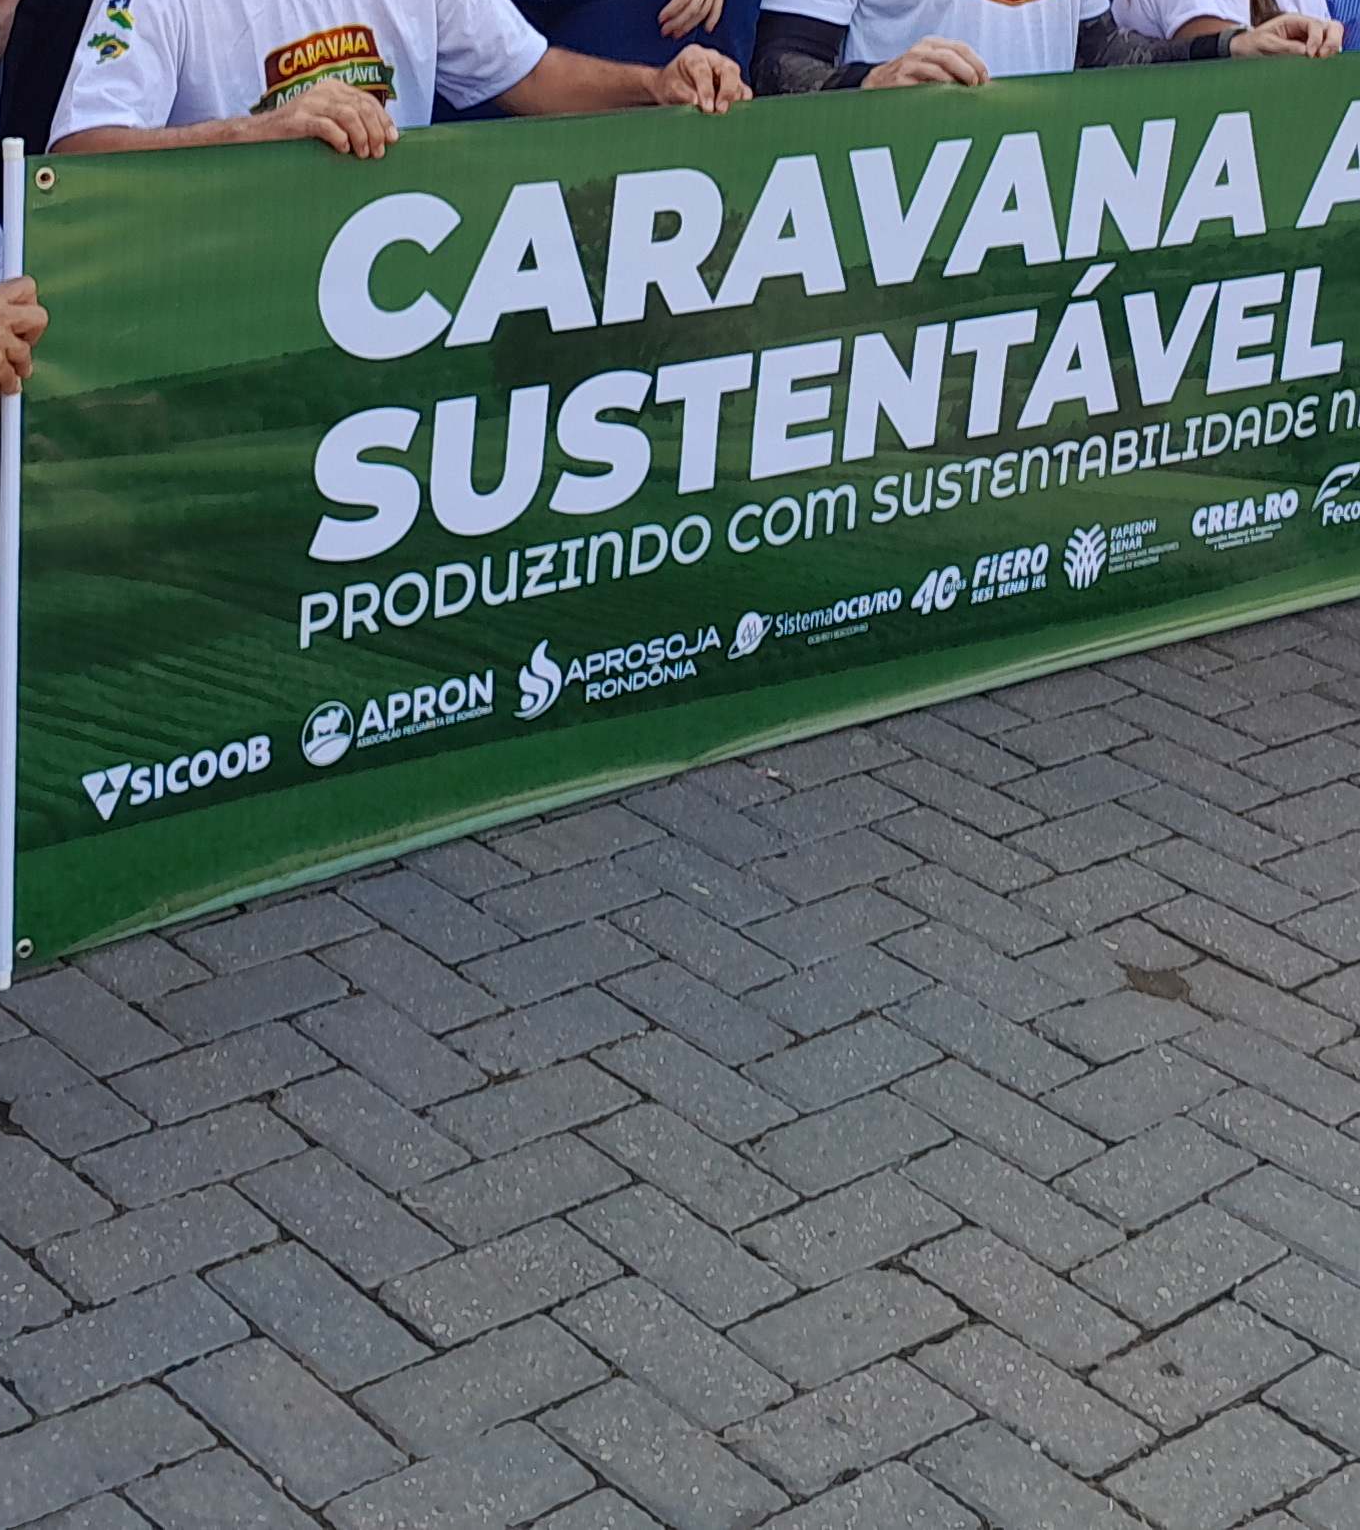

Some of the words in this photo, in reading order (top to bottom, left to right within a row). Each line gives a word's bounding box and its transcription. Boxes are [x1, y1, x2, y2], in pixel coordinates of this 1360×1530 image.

[318, 110, 1268, 360] CARAVANA
[307, 263, 1345, 563] SUSTENTÁVEL
[298, 515, 713, 650] PRODUZINDO
[871, 395, 1320, 524] SUSTENTABILIDADE
[1191, 488, 1300, 538] CREA-RO
[564, 625, 722, 686] APROSOJA
[585, 658, 698, 704] RONDÔNIA
[357, 670, 494, 738] APRON
[129, 735, 271, 806] SICOOB
